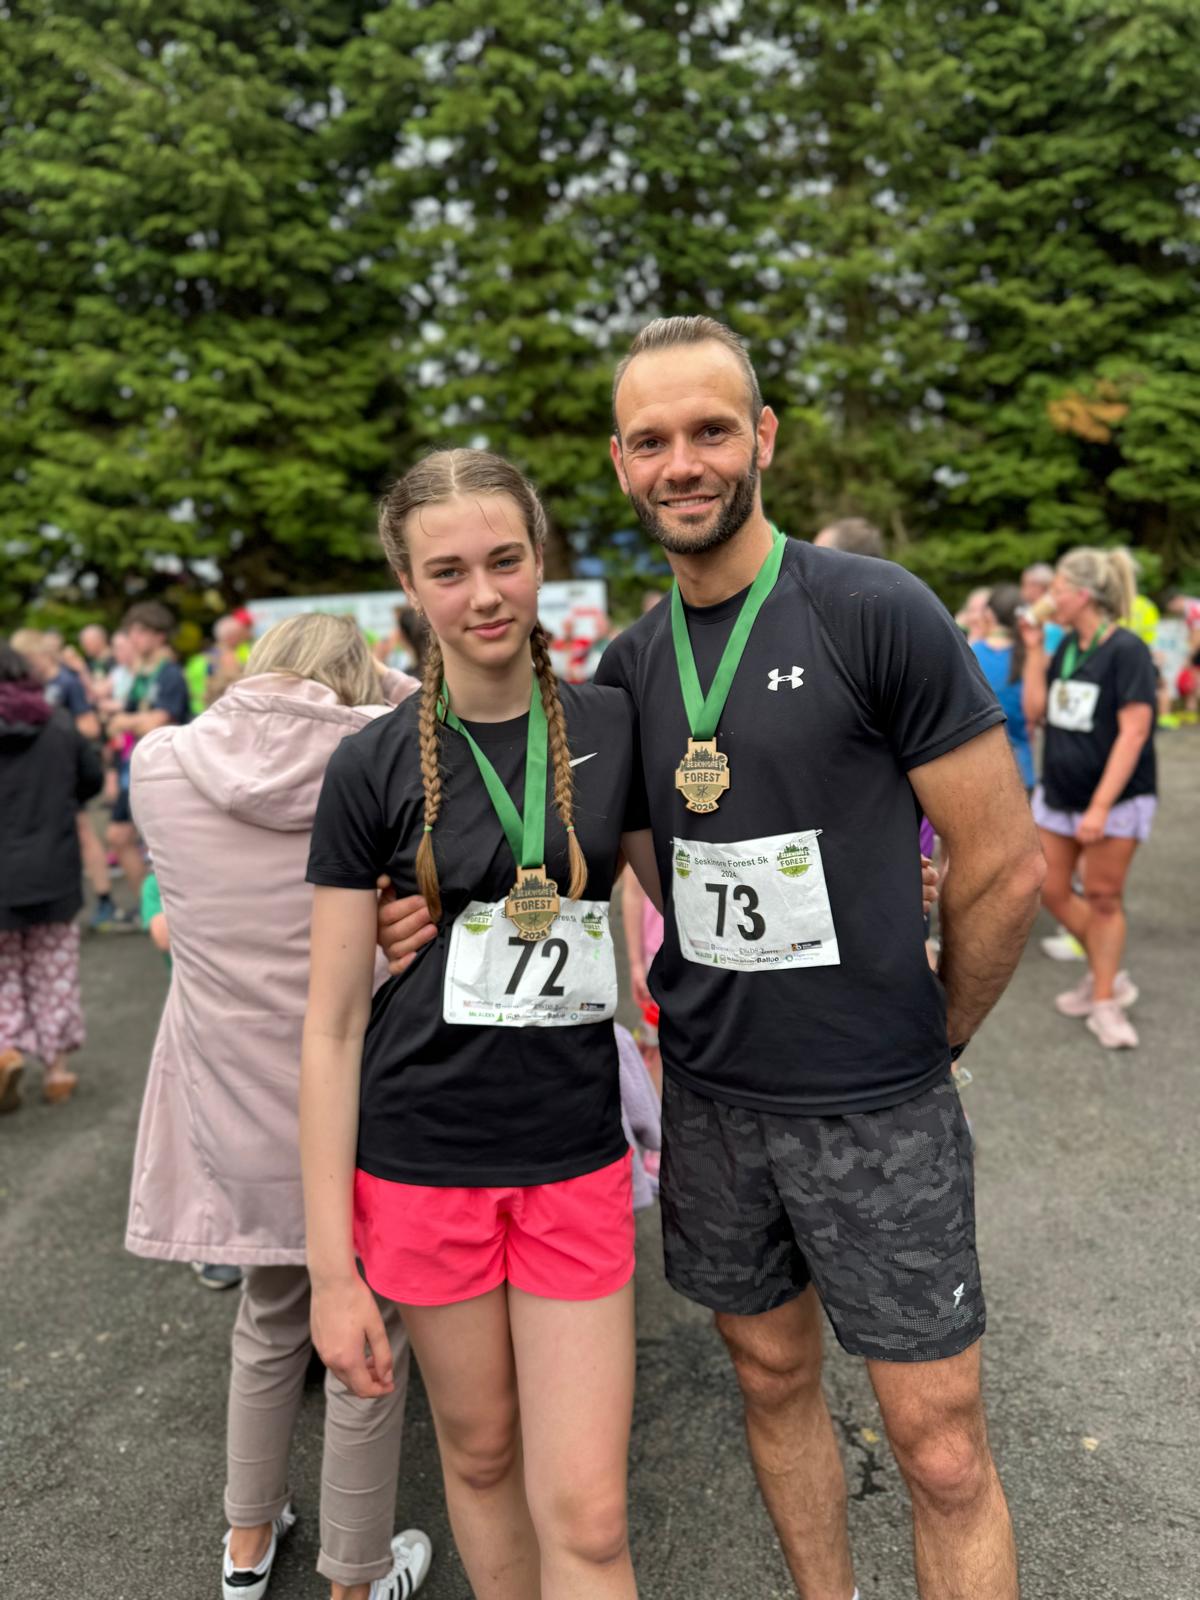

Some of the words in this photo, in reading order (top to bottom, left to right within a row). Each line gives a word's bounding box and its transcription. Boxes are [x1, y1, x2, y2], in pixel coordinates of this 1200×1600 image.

[684, 772, 721, 783] FOREST
[690, 802, 715, 812] 2024
[727, 858, 756, 868] Forest
[757, 856, 769, 865] 5k
[780, 857, 808, 867] FOREST
[514, 899, 552, 912] FOREST
[705, 882, 766, 941] 73
[523, 931, 547, 940] 2024
[504, 936, 569, 997] 72
